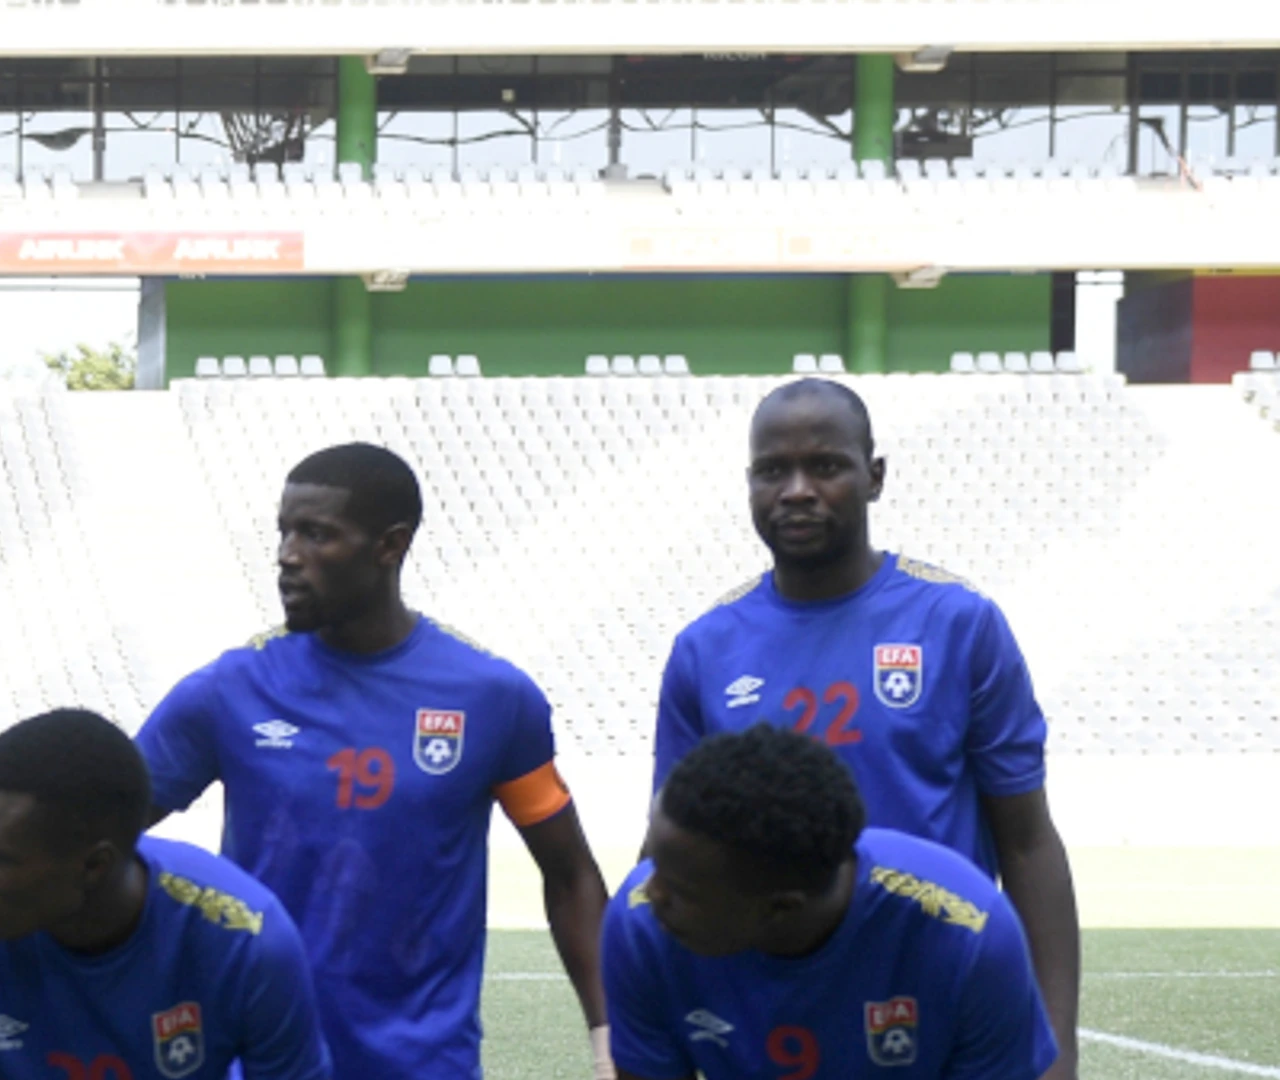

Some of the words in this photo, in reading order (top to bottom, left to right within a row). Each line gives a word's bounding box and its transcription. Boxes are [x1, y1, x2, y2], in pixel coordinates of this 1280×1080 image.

[18, 239, 124, 260] AIRLINK
[173, 239, 279, 260] AIRLINK
[881, 648, 915, 664] EFA
[424, 714, 457, 731] EFA
[782, 681, 862, 745] 22
[327, 746, 395, 810] 19
